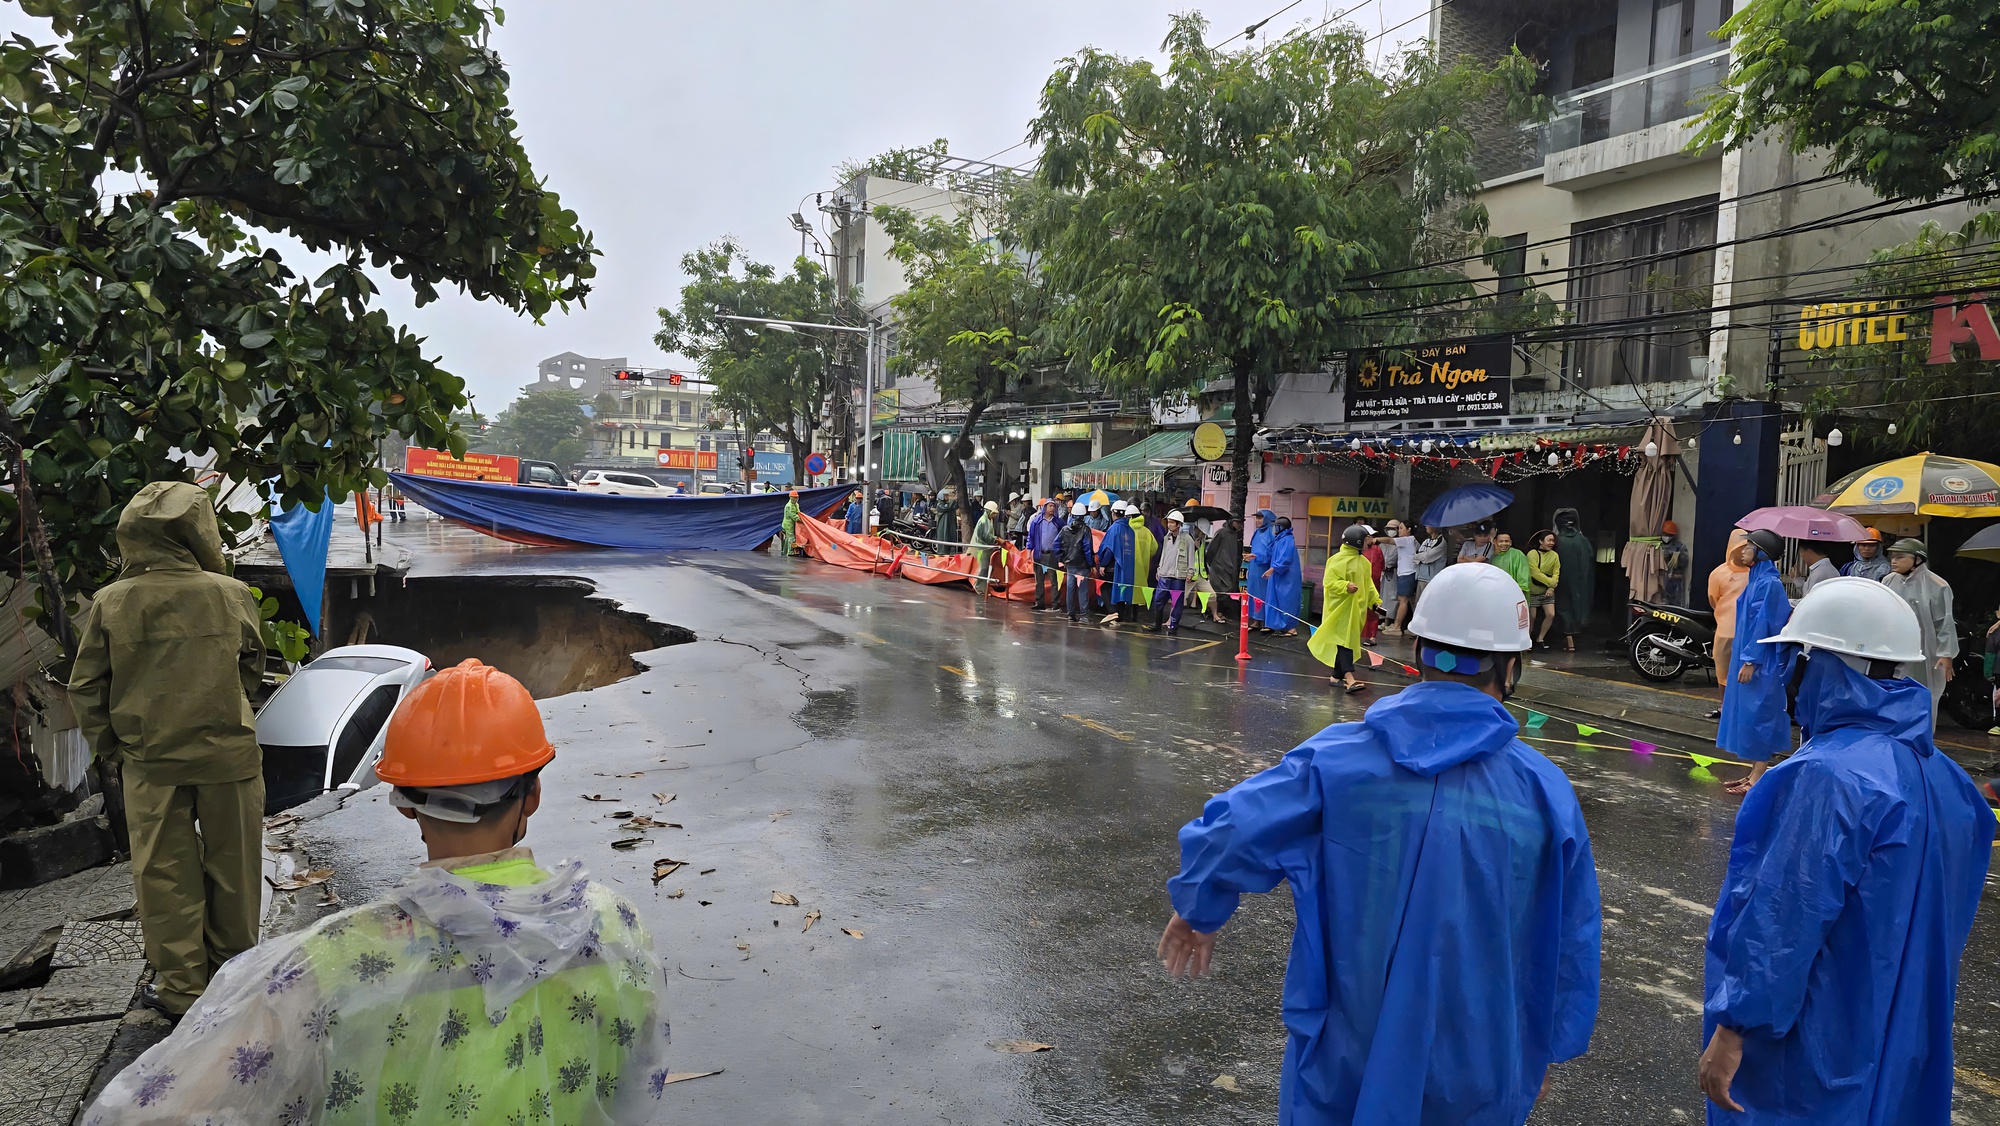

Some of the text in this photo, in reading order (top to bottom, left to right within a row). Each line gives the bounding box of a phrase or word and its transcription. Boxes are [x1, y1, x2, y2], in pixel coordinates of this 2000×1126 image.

[1799, 301, 1908, 351] COFFEE
[670, 376, 680, 384] 30
[1388, 361, 1488, 389] Trà Ngon
[1381, 396, 1394, 407] TRÀ
[1413, 395, 1427, 405] TRÀ
[1428, 393, 1443, 404] TRÁI
[1445, 392, 1459, 403] CÂY
[1465, 391, 1487, 402] NƯỚC
[1387, 407, 1400, 417] Công
[1336, 498, 1388, 516] ĂN VẬT
[1653, 610, 1680, 623] DQTV
